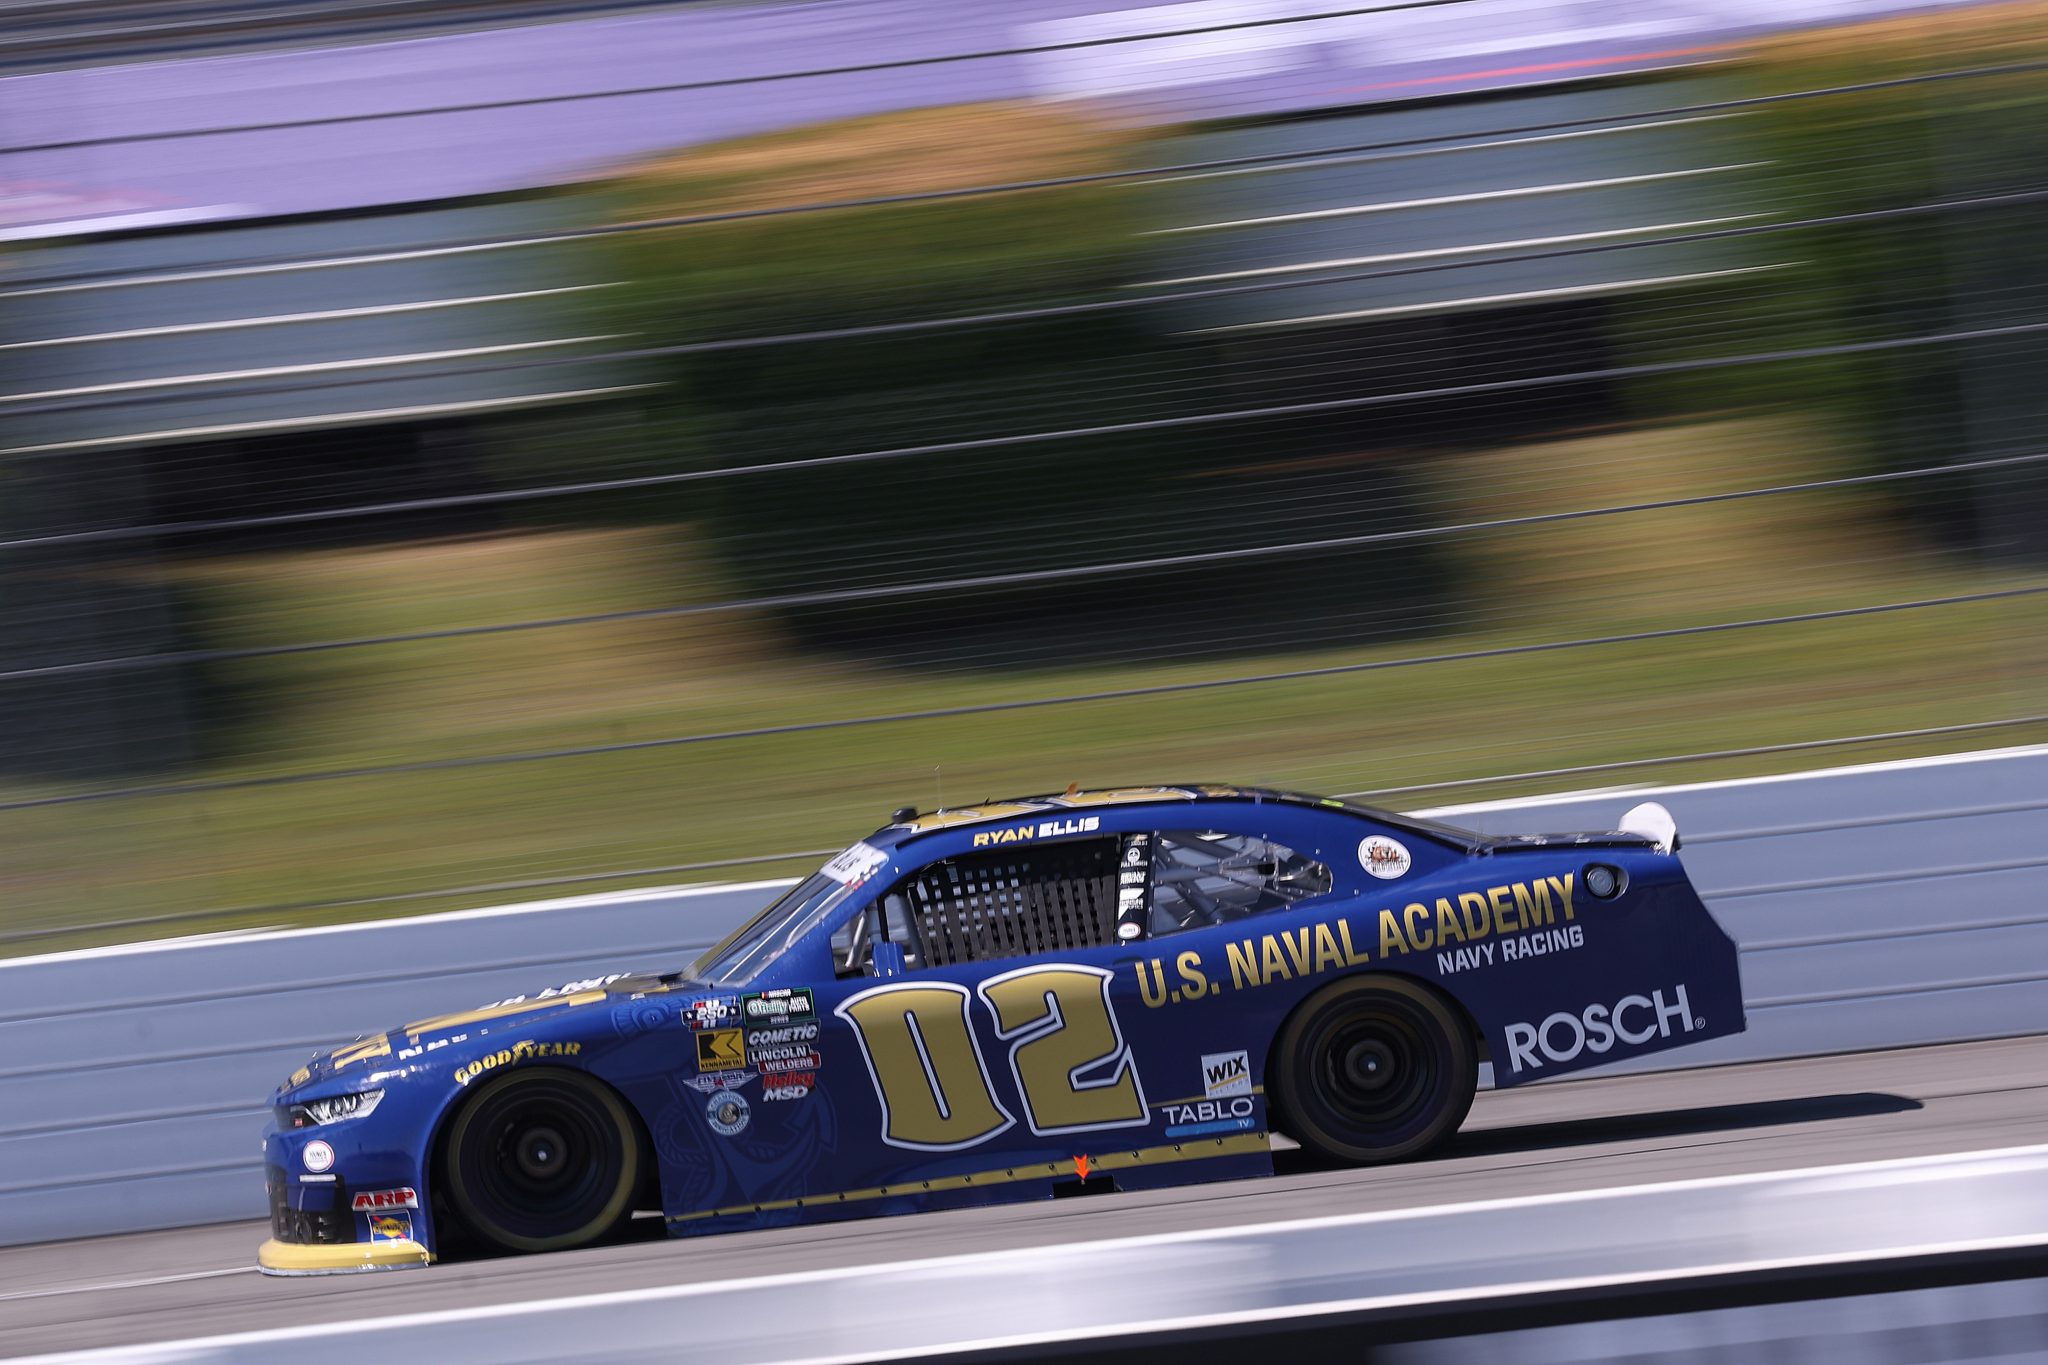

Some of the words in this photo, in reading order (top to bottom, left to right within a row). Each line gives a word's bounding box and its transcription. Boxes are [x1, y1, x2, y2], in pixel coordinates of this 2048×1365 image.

[973, 825, 1035, 847] RYAN
[1038, 816, 1101, 838] ELLIS
[1134, 957, 1222, 1009] U.S.
[1225, 918, 1369, 990] NAVAL
[1378, 873, 1577, 959] ACADEMY
[1436, 943, 1496, 976] NAVY
[1502, 924, 1585, 961] RACING
[768, 988, 792, 998] NASCAR
[696, 1005, 728, 1021] 250
[749, 1024, 818, 1045] COMETIC
[1504, 985, 1694, 1073] ROSCH
[453, 1039, 582, 1086] GOODYEAR
[701, 1059, 743, 1069] KENNAMETAL
[750, 1046, 807, 1062] LINCOLN
[833, 963, 1151, 1152] 02
[763, 1072, 816, 1088] Holley
[1206, 1055, 1247, 1084] WIX
[763, 1085, 809, 1102] MSD
[1162, 1097, 1254, 1126] TABLO
[1237, 1120, 1250, 1128] TV
